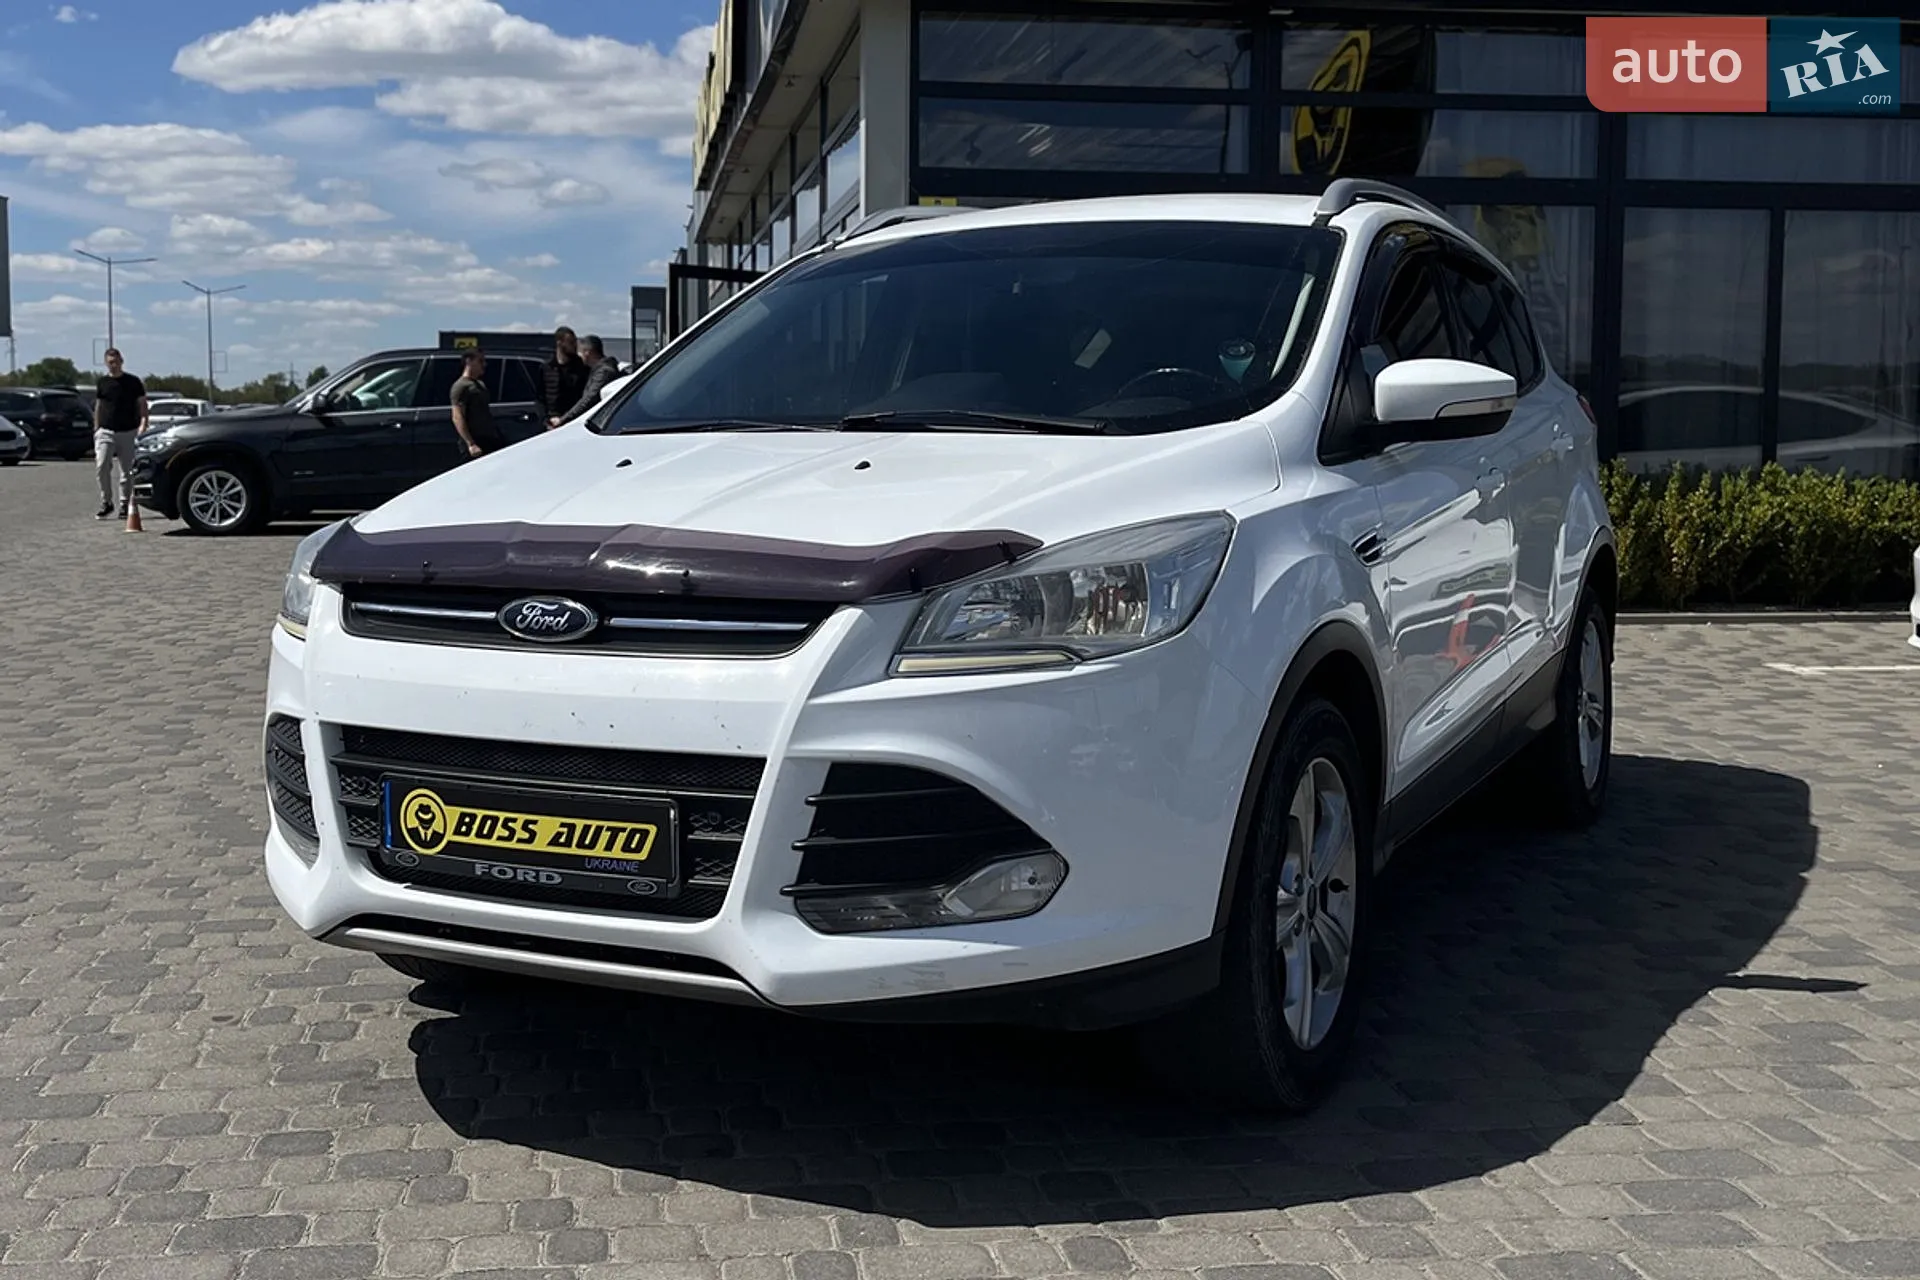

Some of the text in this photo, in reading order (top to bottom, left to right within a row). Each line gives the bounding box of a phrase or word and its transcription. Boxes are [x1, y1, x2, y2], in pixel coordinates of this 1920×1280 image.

[515, 600, 571, 630] Ford
[453, 811, 651, 854] BOSS AUTO
[475, 862, 563, 885] FORD
[585, 857, 640, 872] UKRAINE
